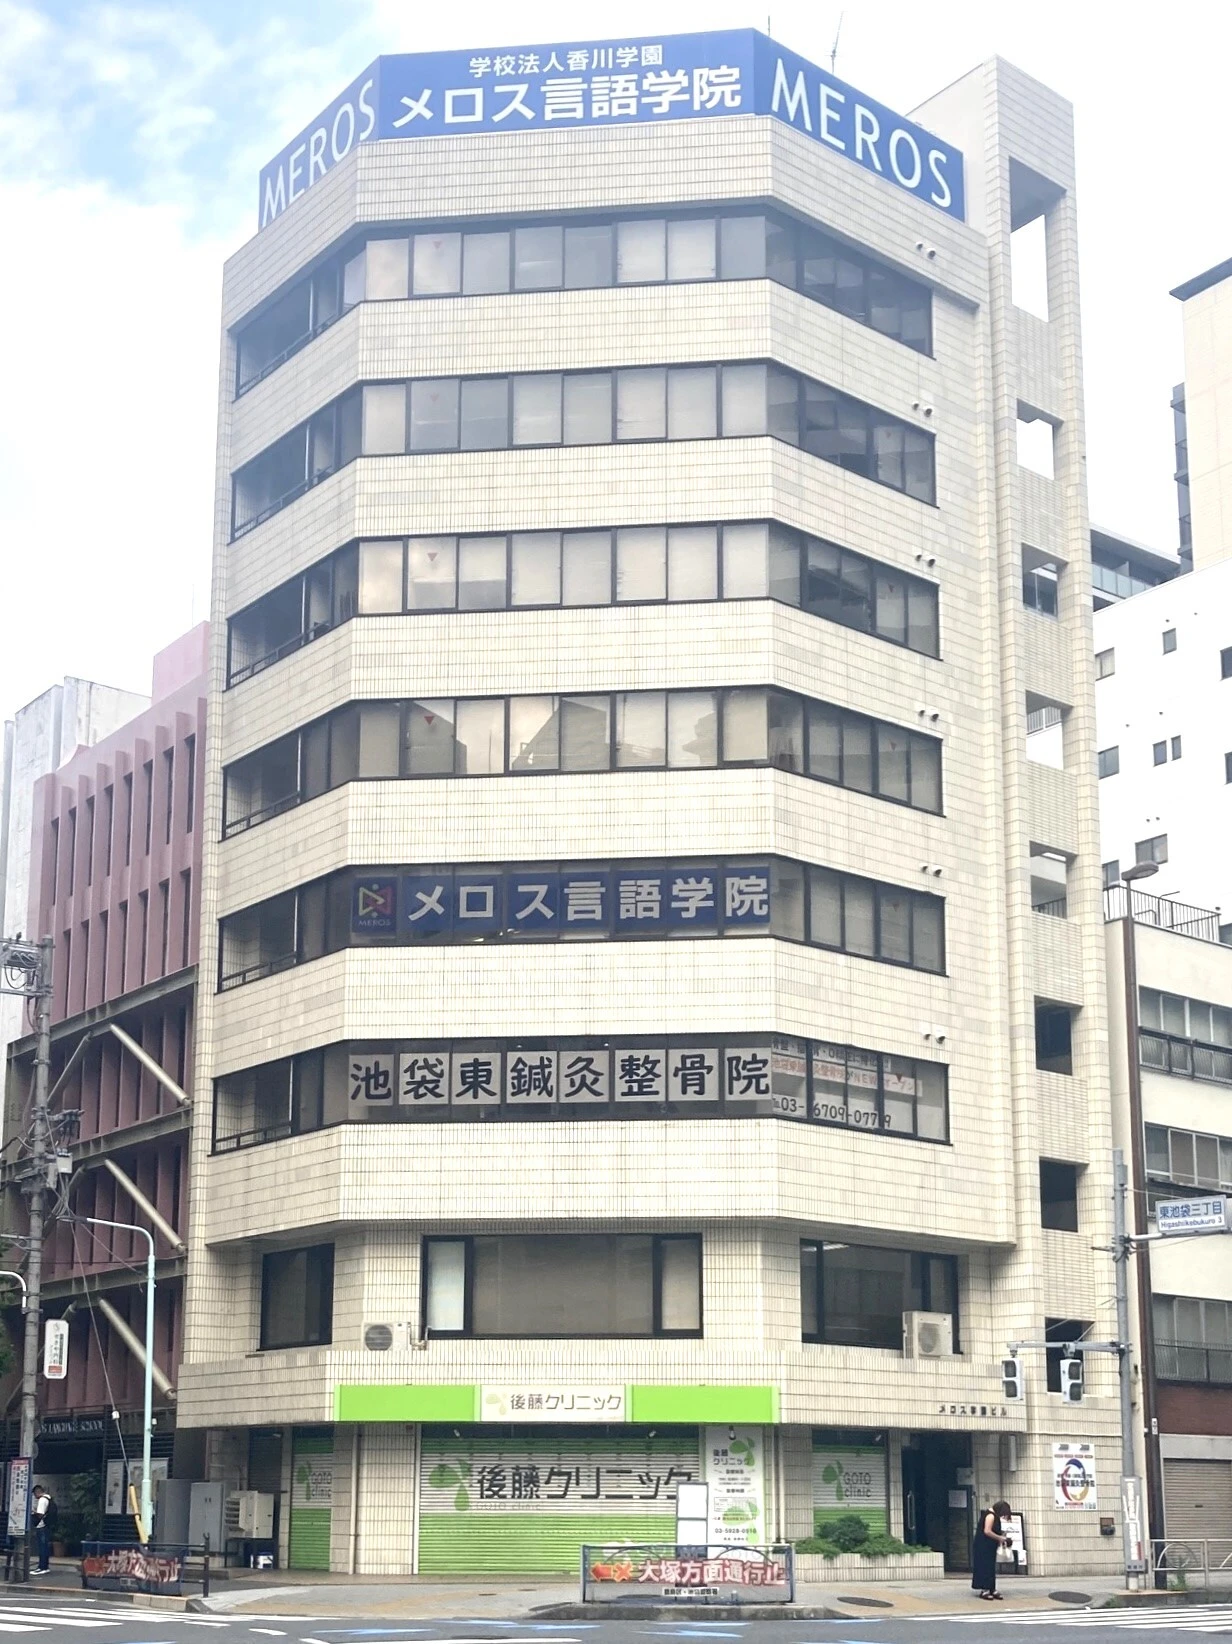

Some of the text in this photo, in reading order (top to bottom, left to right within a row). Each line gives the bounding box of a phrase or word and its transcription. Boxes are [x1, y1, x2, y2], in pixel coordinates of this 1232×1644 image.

[469, 44, 663, 78] 学校法人香川学園
[392, 64, 742, 129] メロス言語学院
[772, 57, 952, 208] MEROS
[262, 78, 376, 228] MEROS
[408, 875, 770, 922] メロス言語学院
[358, 919, 391, 927] MEROS
[350, 1053, 772, 1101] 池袋東鍼灸整骨院
[1159, 1200, 1222, 1219] 東池袋三丁目
[1160, 1218, 1216, 1229] Higashiikebukuro
[510, 1393, 622, 1411] 後藤クリニック
[477, 1464, 692, 1499] 後藤クリニック
[843, 1471, 872, 1485] GOTO
[844, 1485, 872, 1498] clinic
[638, 1559, 786, 1586] 大塚方面通行止
